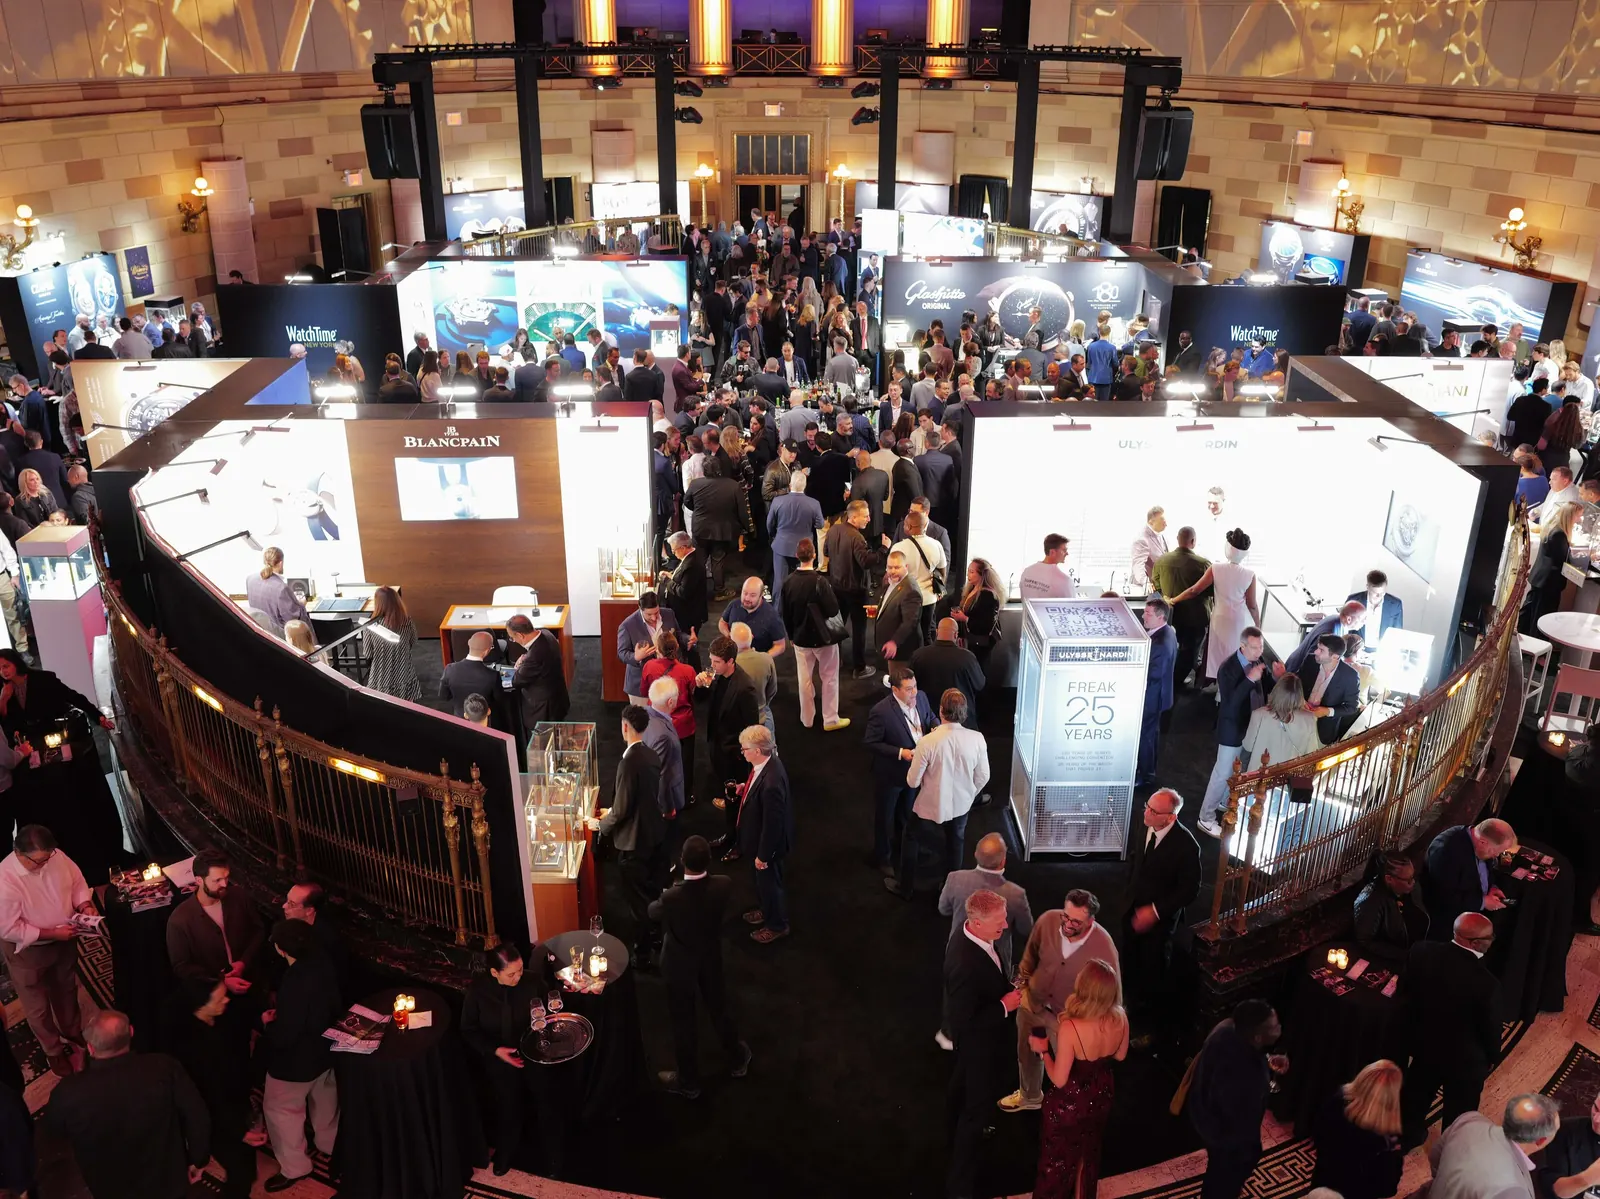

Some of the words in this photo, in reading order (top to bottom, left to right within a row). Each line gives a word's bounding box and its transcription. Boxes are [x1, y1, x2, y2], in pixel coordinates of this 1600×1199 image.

[905, 280, 966, 305] Glashütte
[1092, 281, 1119, 302] 180
[285, 325, 337, 341] WatchTime
[404, 435, 500, 448] BLANCPAIN
[1068, 682, 1116, 692] FREAK
[1065, 696, 1115, 725] 25
[1065, 728, 1112, 740] YEARS
